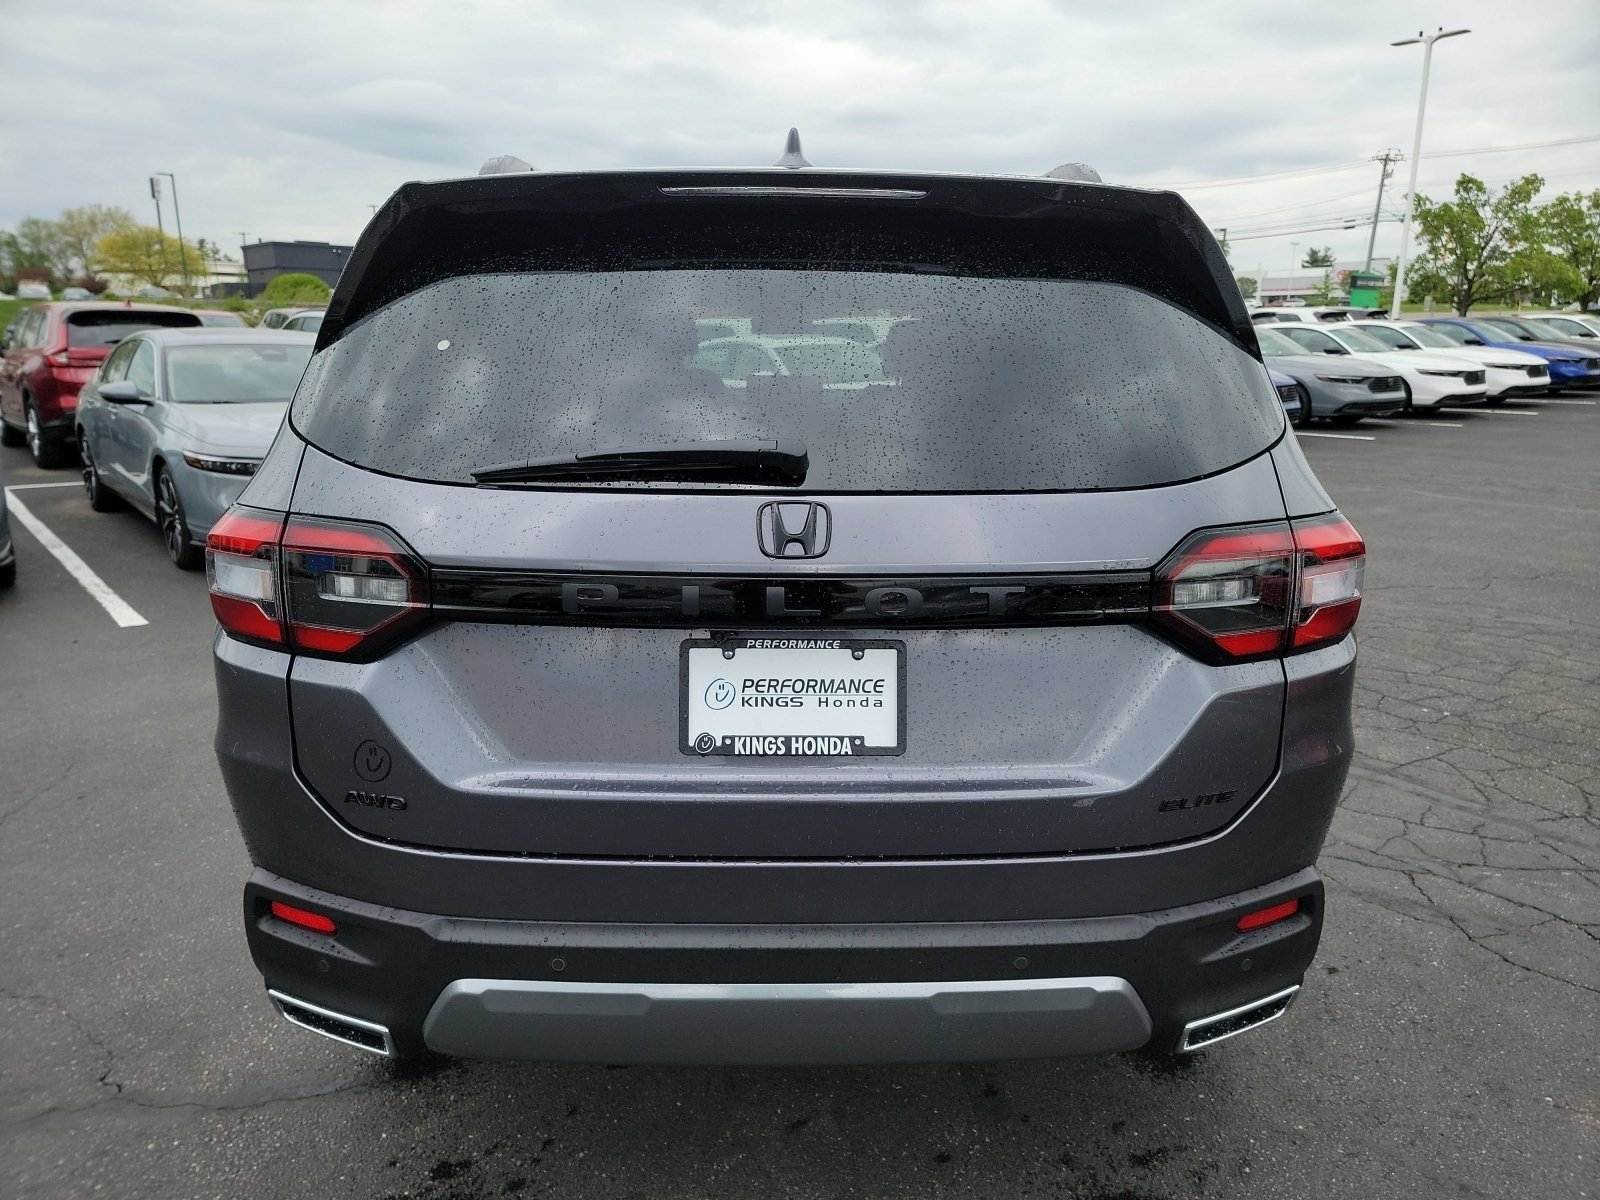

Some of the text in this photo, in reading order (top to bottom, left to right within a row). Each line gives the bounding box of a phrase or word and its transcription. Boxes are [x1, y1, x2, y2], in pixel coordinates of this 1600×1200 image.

[562, 583, 1025, 616] PILOT
[747, 639, 840, 649] PERFORMANCE
[741, 678, 885, 694] PERFORMANCE
[741, 696, 883, 707] KINGS Honda
[734, 737, 853, 755] KINGS HONDA
[344, 790, 408, 810] AWD
[1159, 789, 1238, 812] ELITE
